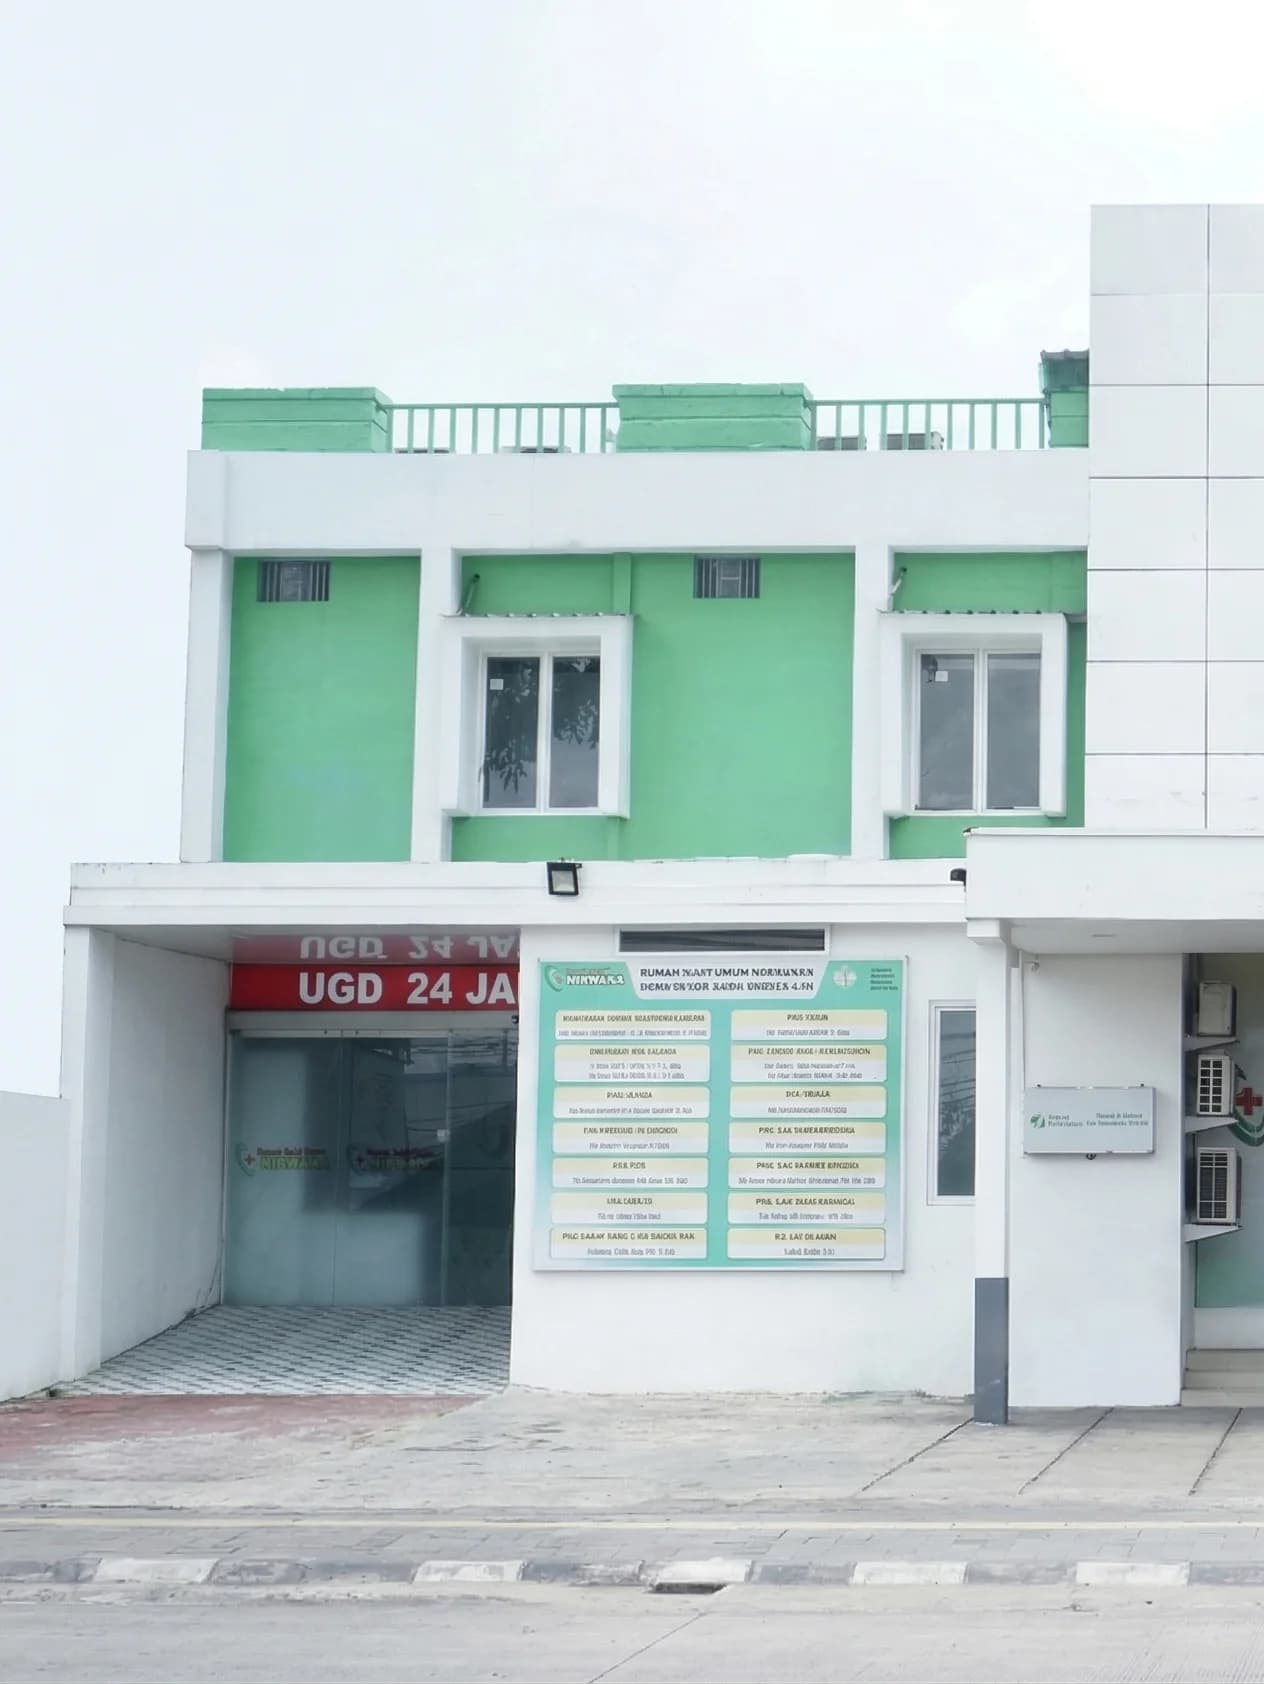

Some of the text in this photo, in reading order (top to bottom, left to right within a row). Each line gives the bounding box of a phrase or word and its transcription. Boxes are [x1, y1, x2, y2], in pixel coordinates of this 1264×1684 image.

[714, 968, 749, 977] UMUM
[300, 972, 520, 1004] UGD 24 JA
